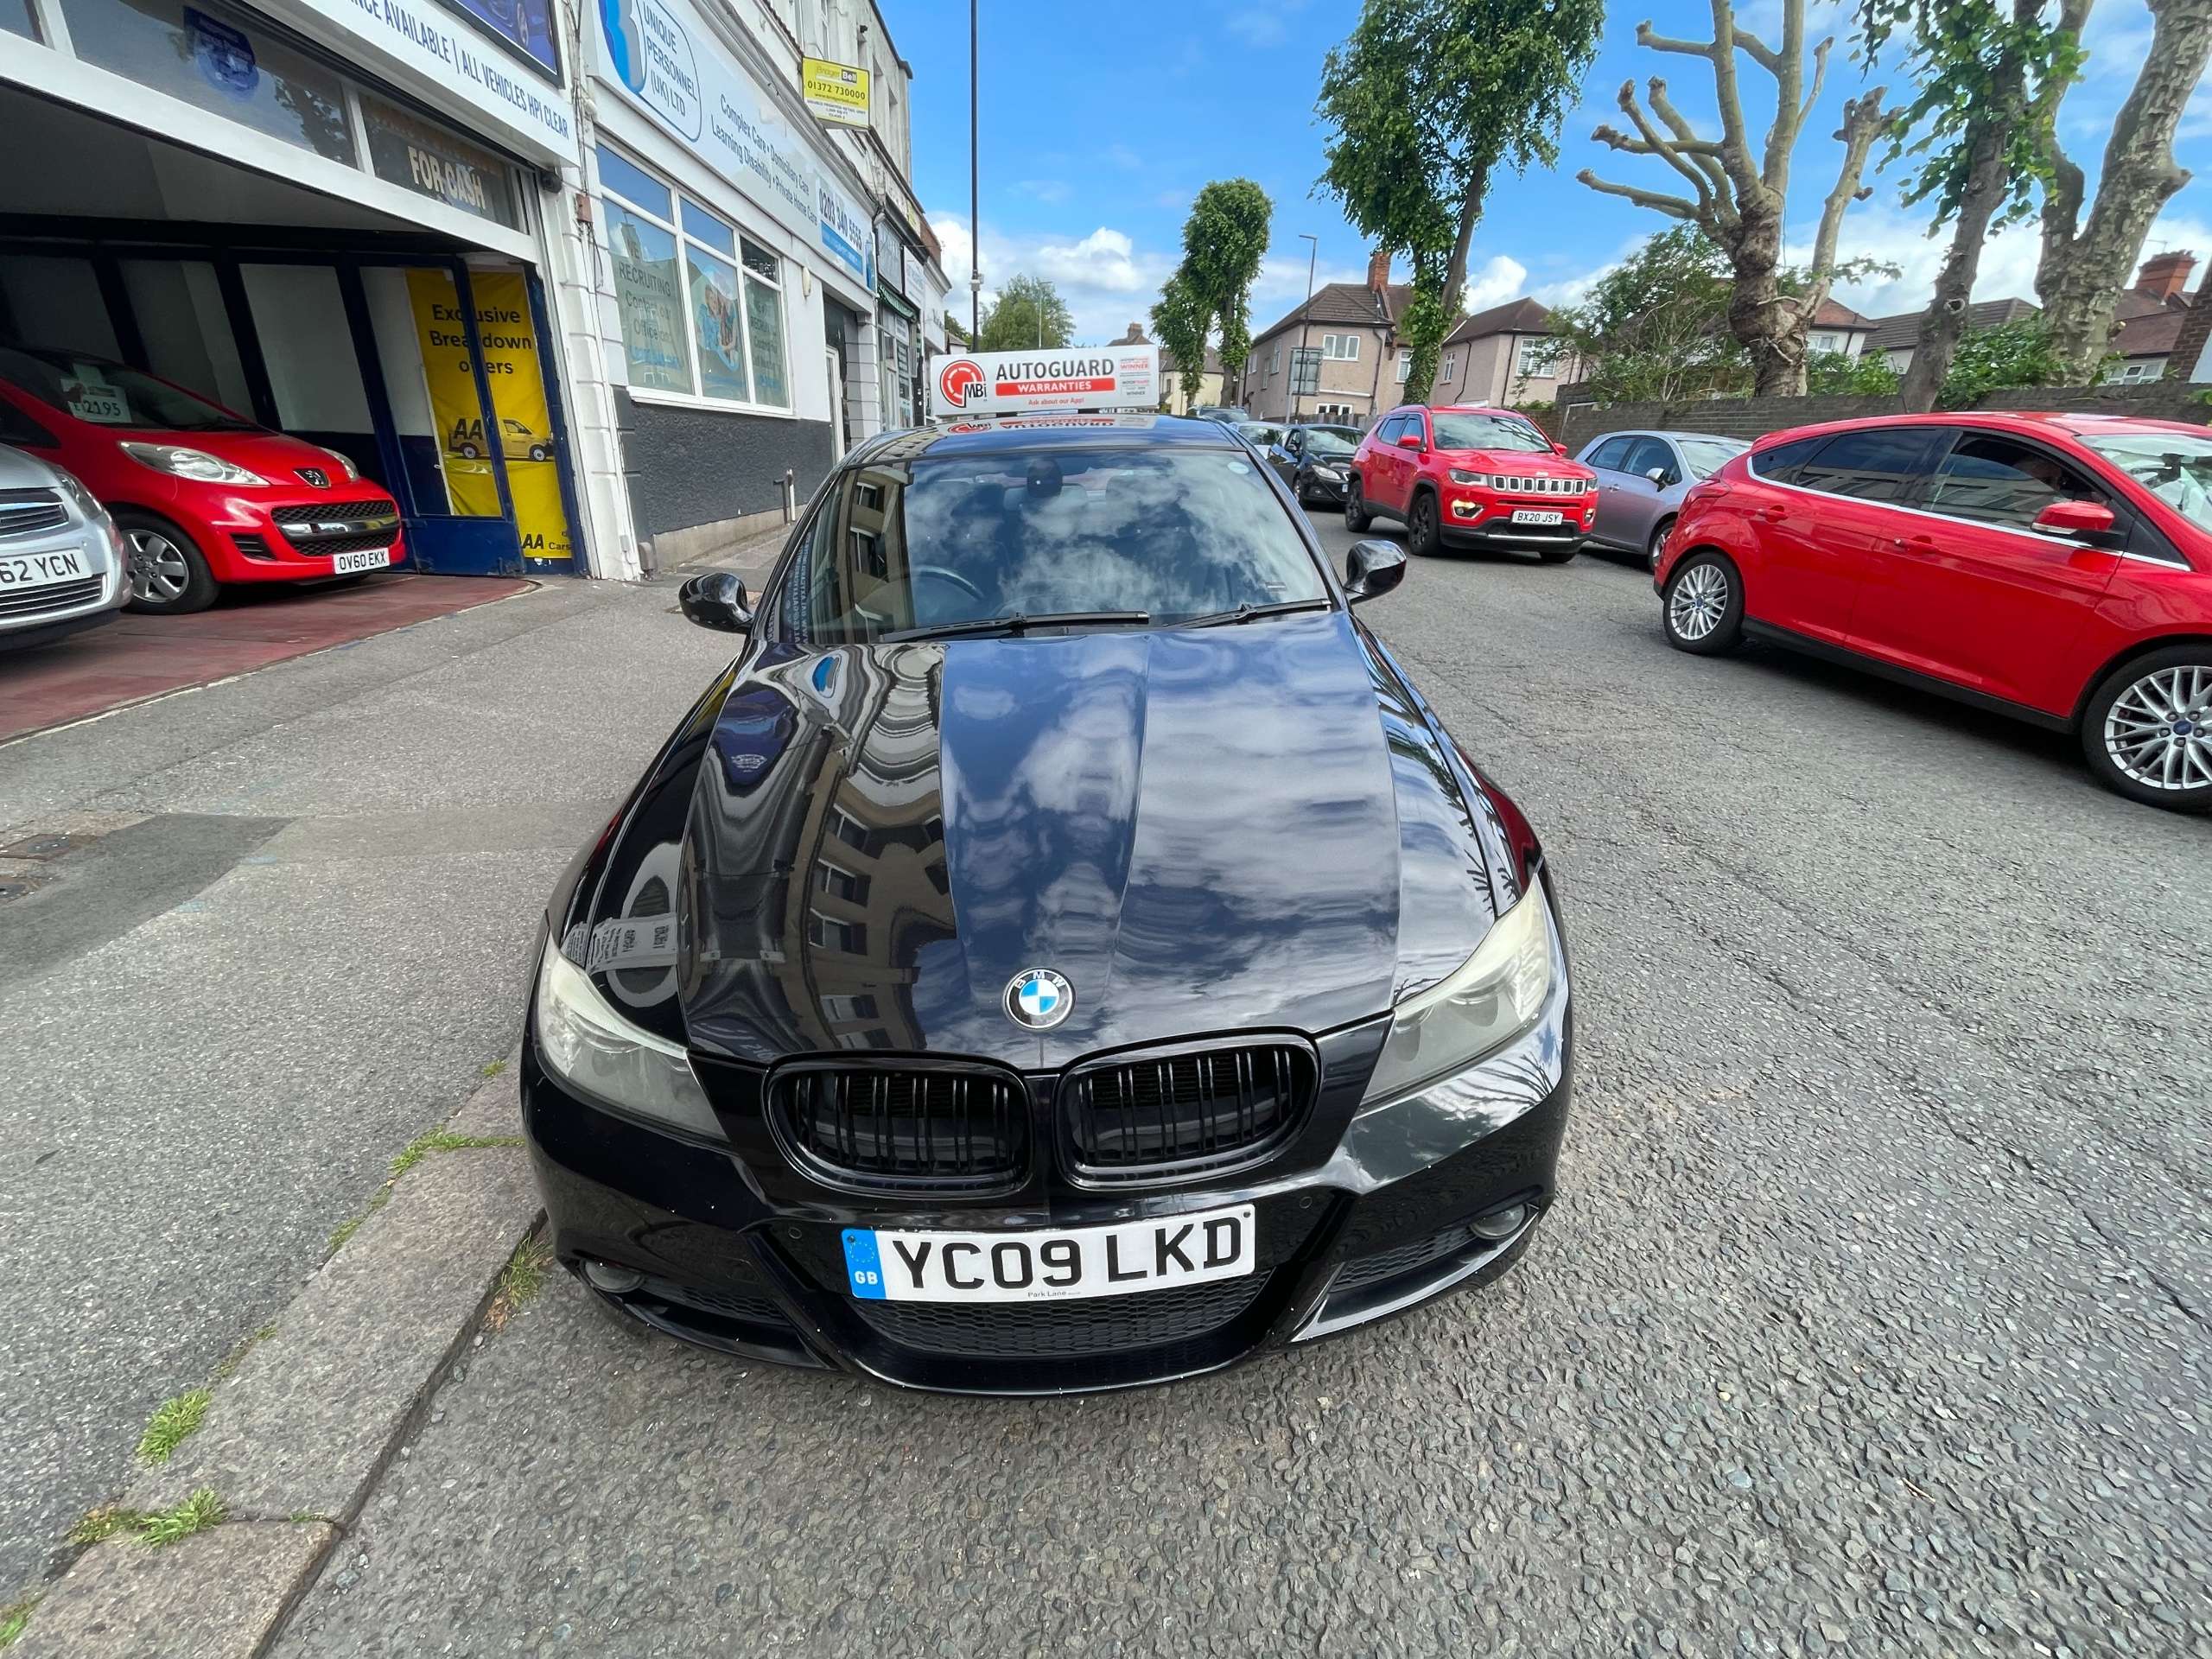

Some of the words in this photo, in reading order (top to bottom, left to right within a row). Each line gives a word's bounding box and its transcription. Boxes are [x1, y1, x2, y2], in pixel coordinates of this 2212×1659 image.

[643, 1, 677, 54] UNIQUE
[385, 0, 451, 64] AVAILABLE
[461, 49, 482, 84] ALL
[480, 62, 527, 111] VEHICLES
[527, 93, 543, 122] HPI
[543, 105, 569, 140] CLEAR
[646, 35, 697, 102] PERSONNEL
[842, 71, 856, 82] Bell
[651, 69, 670, 108] (UK)
[670, 88, 686, 117] LTD
[807, 80, 832, 92] 01372
[835, 85, 866, 100] 730000
[721, 93, 751, 139] Complex
[751, 125, 766, 154] Care
[798, 174, 810, 196] Care
[408, 145, 444, 194] FOR
[444, 161, 486, 210] CASH
[711, 114, 744, 165] Learning
[743, 144, 772, 189] Disability
[793, 194, 807, 216] Home
[807, 205, 818, 226] Care
[819, 188, 836, 226] 0203
[619, 261, 671, 297] RECRUITING
[432, 303, 521, 323] Excusive
[429, 330, 532, 350] Breadown
[459, 359, 514, 374] oers
[996, 359, 1115, 380] AUTOGUARD
[964, 382, 988, 398] MBi
[1017, 380, 1092, 393] WARRANTIES
[454, 417, 484, 440] AA
[1517, 512, 1541, 522] BX20
[1542, 513, 1559, 523] JSY
[521, 533, 544, 550] AA
[548, 542, 571, 551] Cars
[0, 560, 33, 583] 62
[34, 553, 80, 578] YCN
[339, 554, 366, 570] OV60
[368, 550, 386, 566] EKX
[1014, 971, 1067, 989] BMW
[893, 1239, 1082, 1290] YC09
[1105, 1217, 1242, 1283] LKD
[855, 1270, 878, 1285] GB
